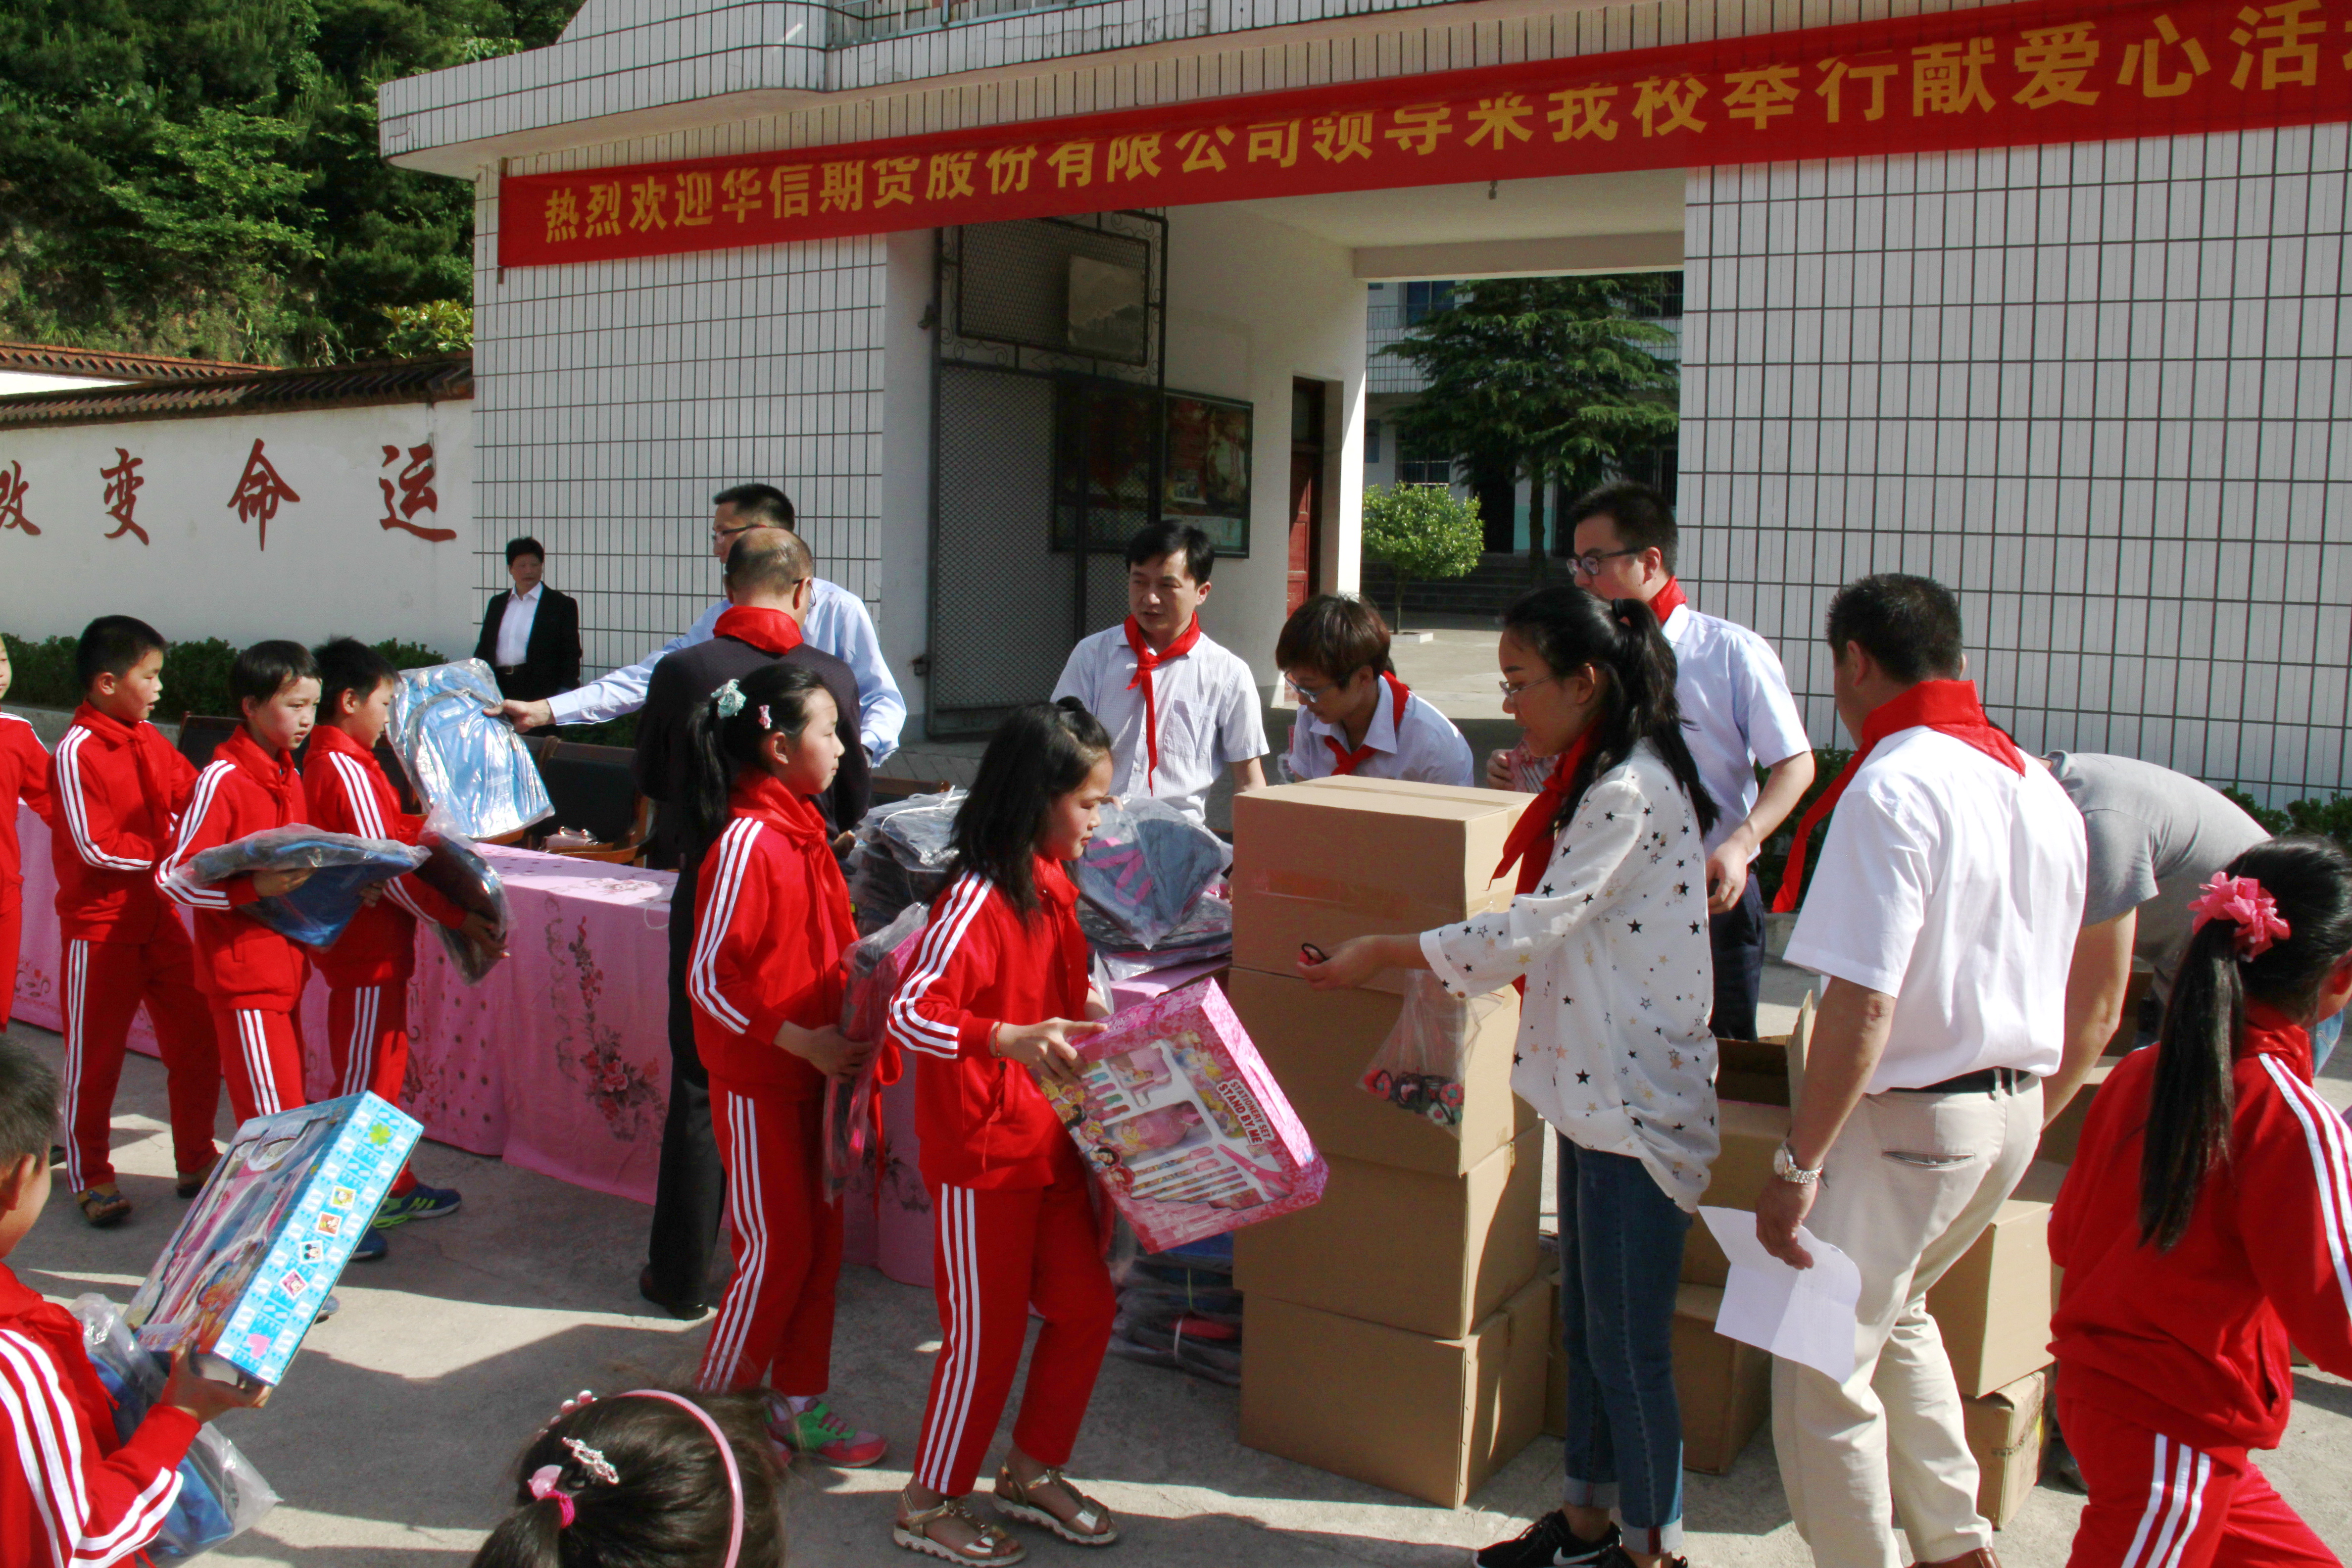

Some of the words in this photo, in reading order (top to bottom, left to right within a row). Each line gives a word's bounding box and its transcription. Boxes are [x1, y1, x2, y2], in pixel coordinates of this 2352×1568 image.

[545, 0, 2352, 243] 热烈欢迎华信期货股份有限公司领导来我校举行献爱心活
[1219, 1083, 1246, 1113] STAND
[1240, 1114, 1255, 1127] BY
[1248, 1129, 1263, 1143] ME
[1230, 1081, 1264, 1123] STATIONERY
[1259, 1125, 1271, 1137] SET
